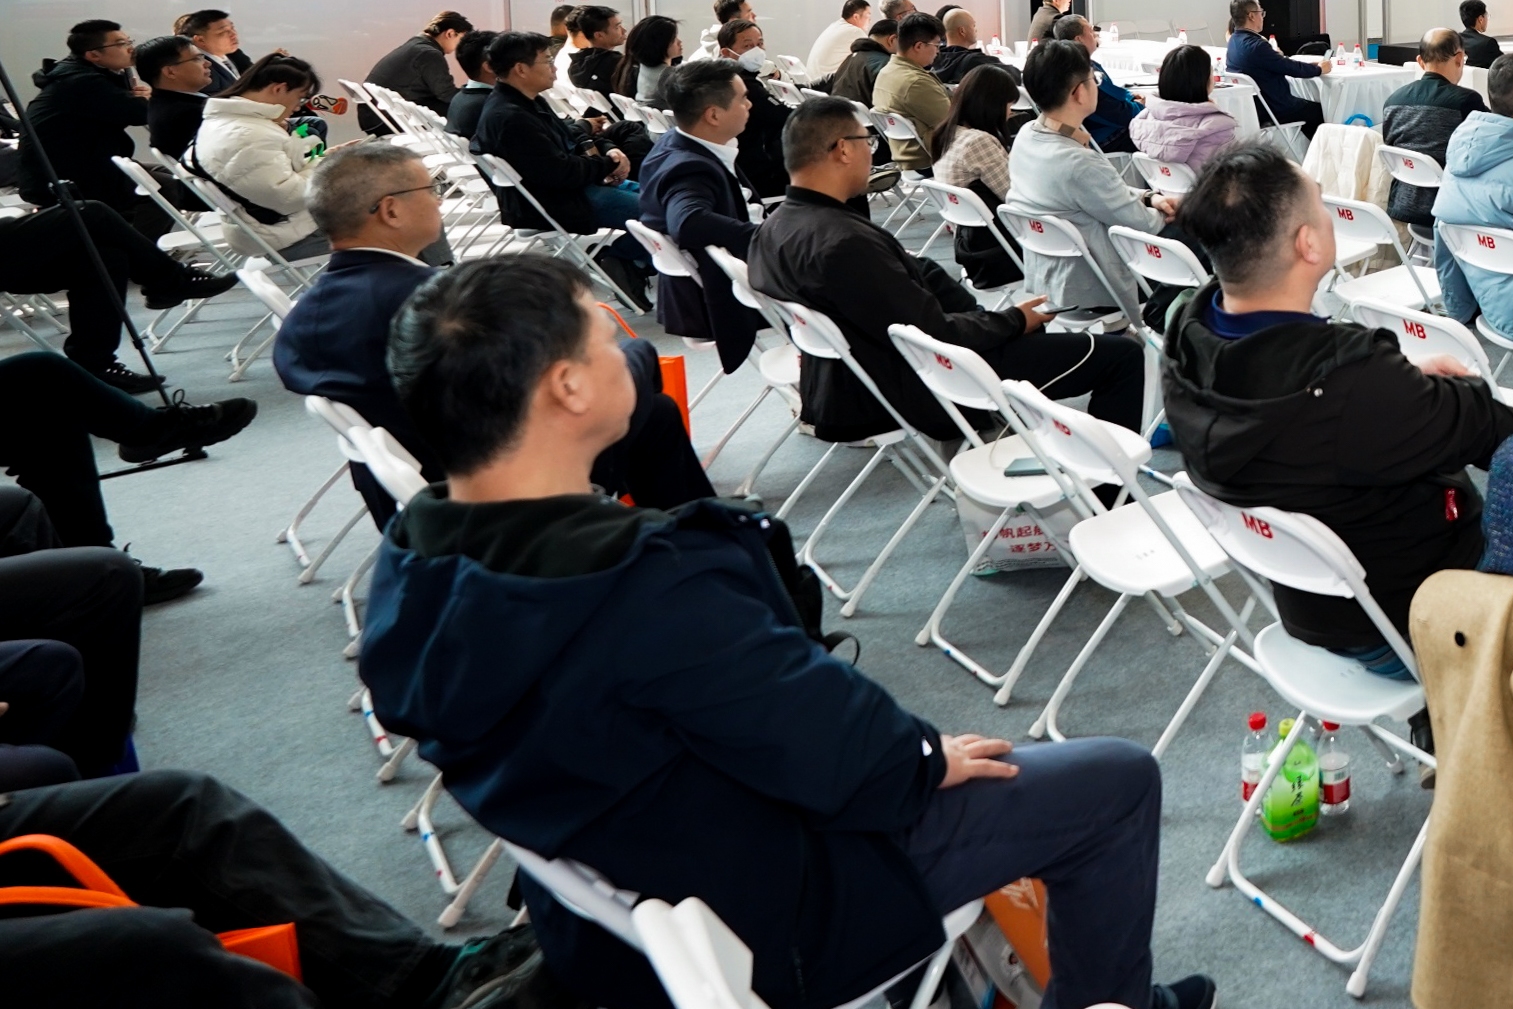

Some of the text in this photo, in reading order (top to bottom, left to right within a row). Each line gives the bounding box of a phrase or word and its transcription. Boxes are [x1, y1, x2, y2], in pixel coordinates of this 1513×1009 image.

[1337, 207, 1354, 221] MB
[1476, 234, 1496, 249] MB
[1145, 243, 1162, 259] MB
[1403, 319, 1426, 340] MB
[1241, 512, 1274, 540] MB
